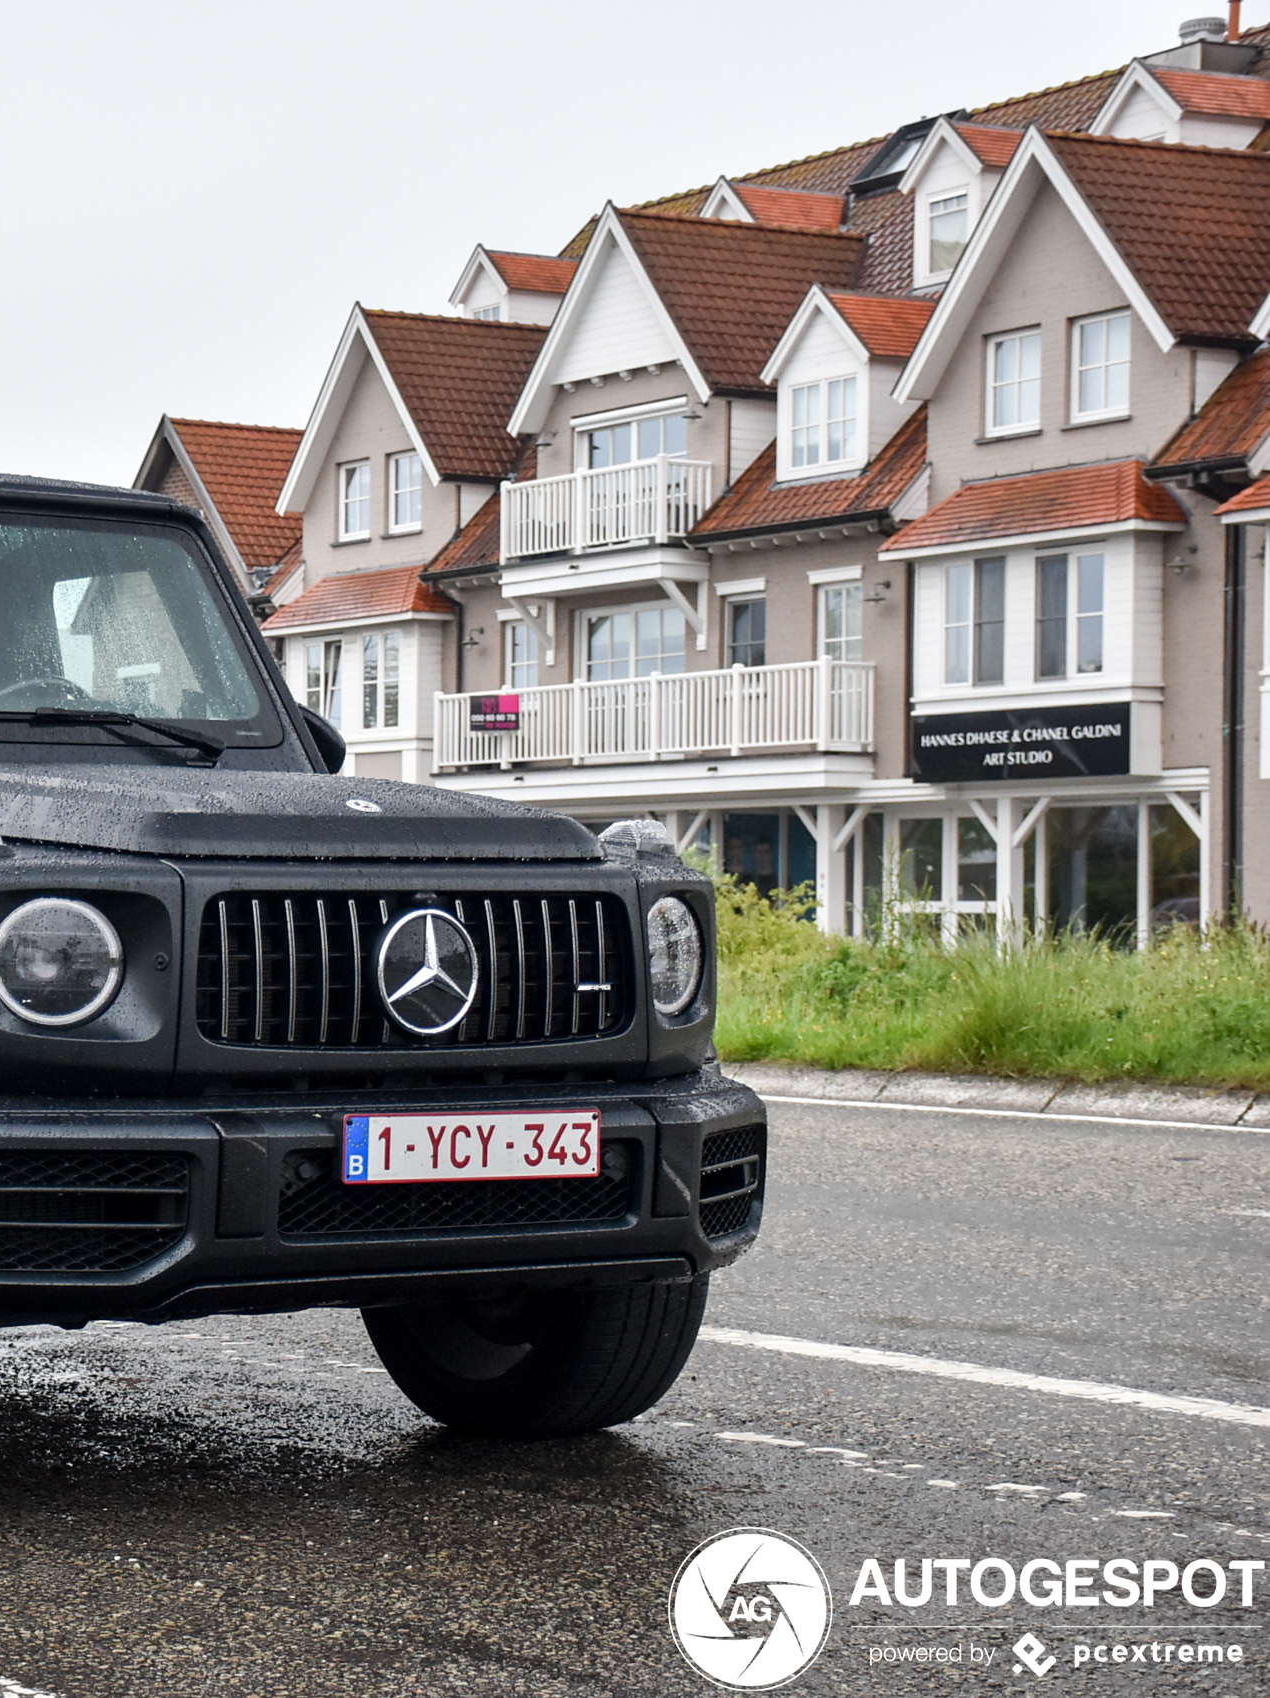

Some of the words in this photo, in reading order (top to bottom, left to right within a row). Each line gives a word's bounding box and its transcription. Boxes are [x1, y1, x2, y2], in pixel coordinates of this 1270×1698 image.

[920, 733, 964, 747] HANNES
[966, 730, 1009, 745] DHAESE
[1011, 729, 1021, 743] &
[1023, 727, 1069, 742] CHANEL
[1071, 724, 1121, 738] GALDINI
[983, 752, 1005, 766] ART
[1006, 750, 1053, 764] STUDIO
[349, 1155, 364, 1176] B
